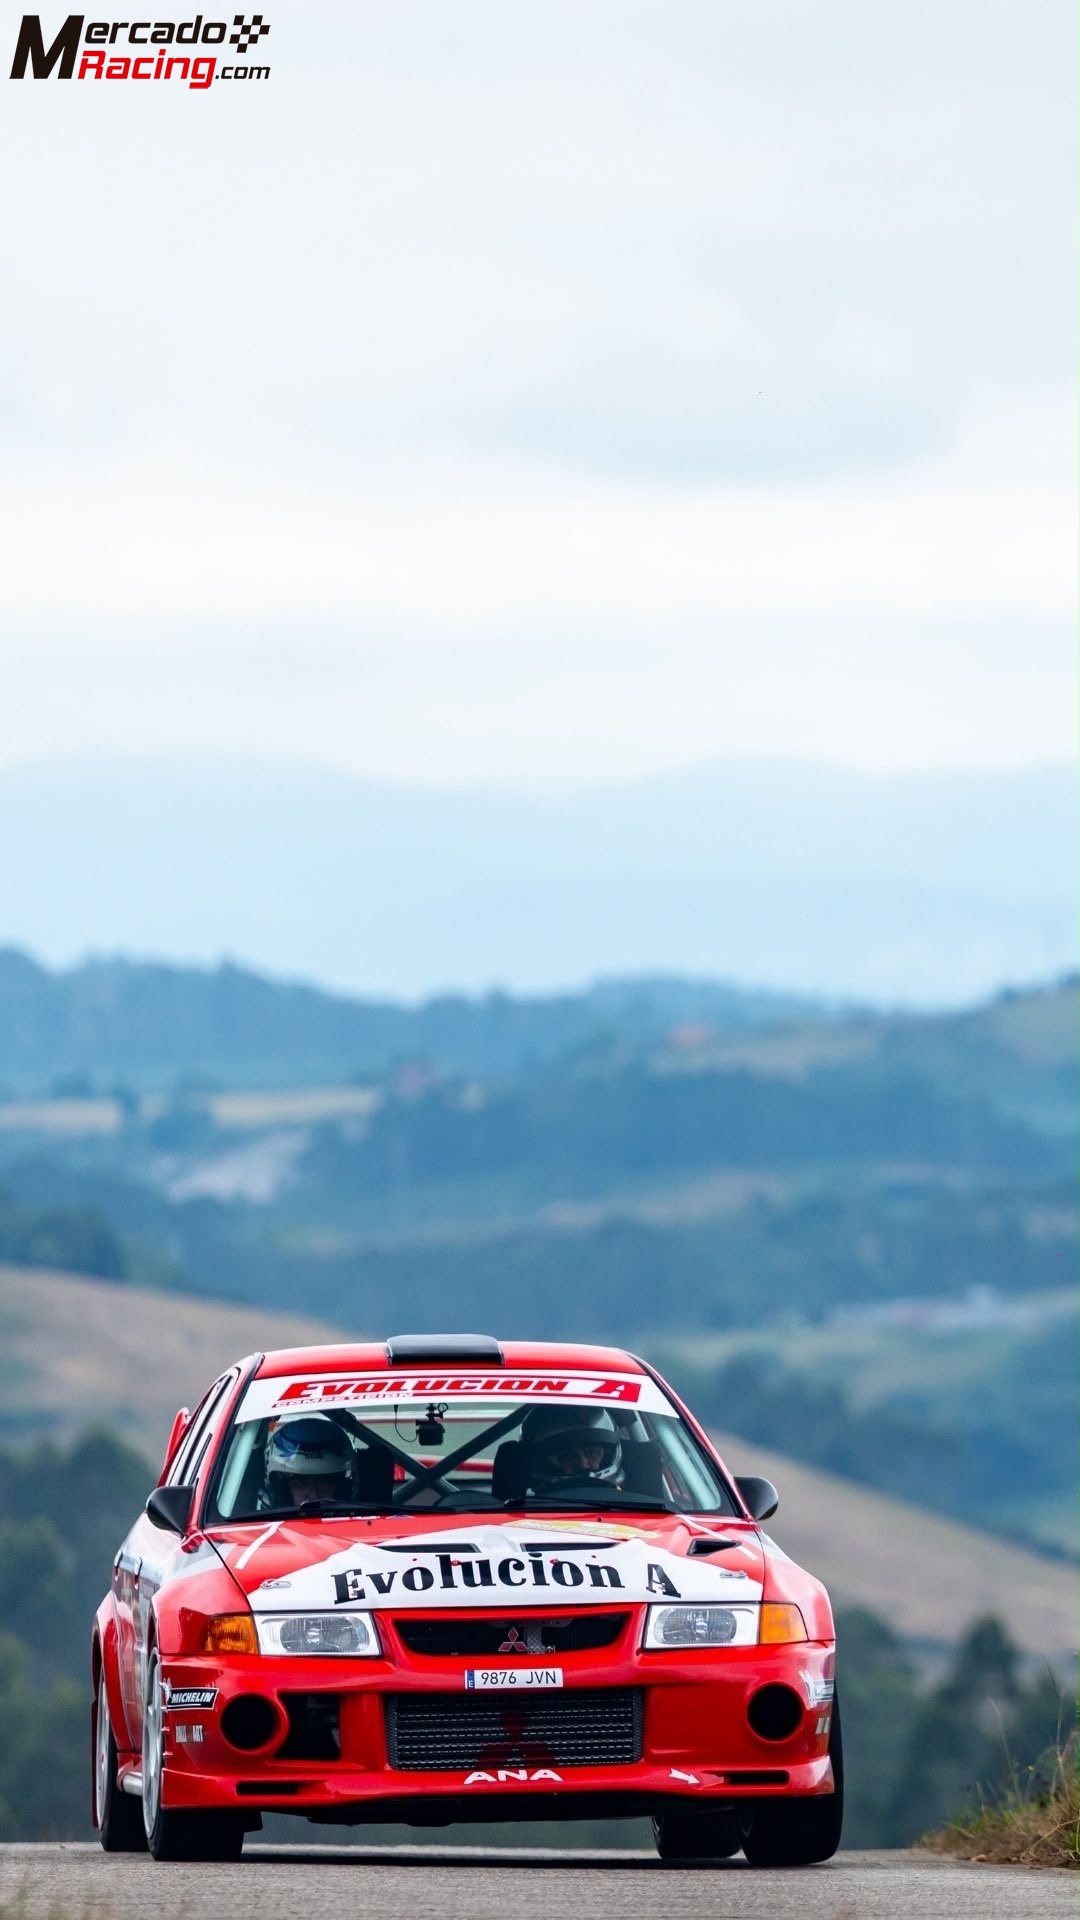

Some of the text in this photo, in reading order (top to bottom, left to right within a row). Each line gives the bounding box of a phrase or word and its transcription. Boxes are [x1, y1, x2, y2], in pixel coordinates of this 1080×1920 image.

[277, 1379, 641, 1402] EVOLUCION A
[330, 1552, 682, 1605] Evolucion A
[468, 1680, 474, 1688] E
[481, 1670, 557, 1685] 9876 JVN
[170, 1692, 215, 1704] MICHELIN
[463, 1769, 564, 1785] ANA
